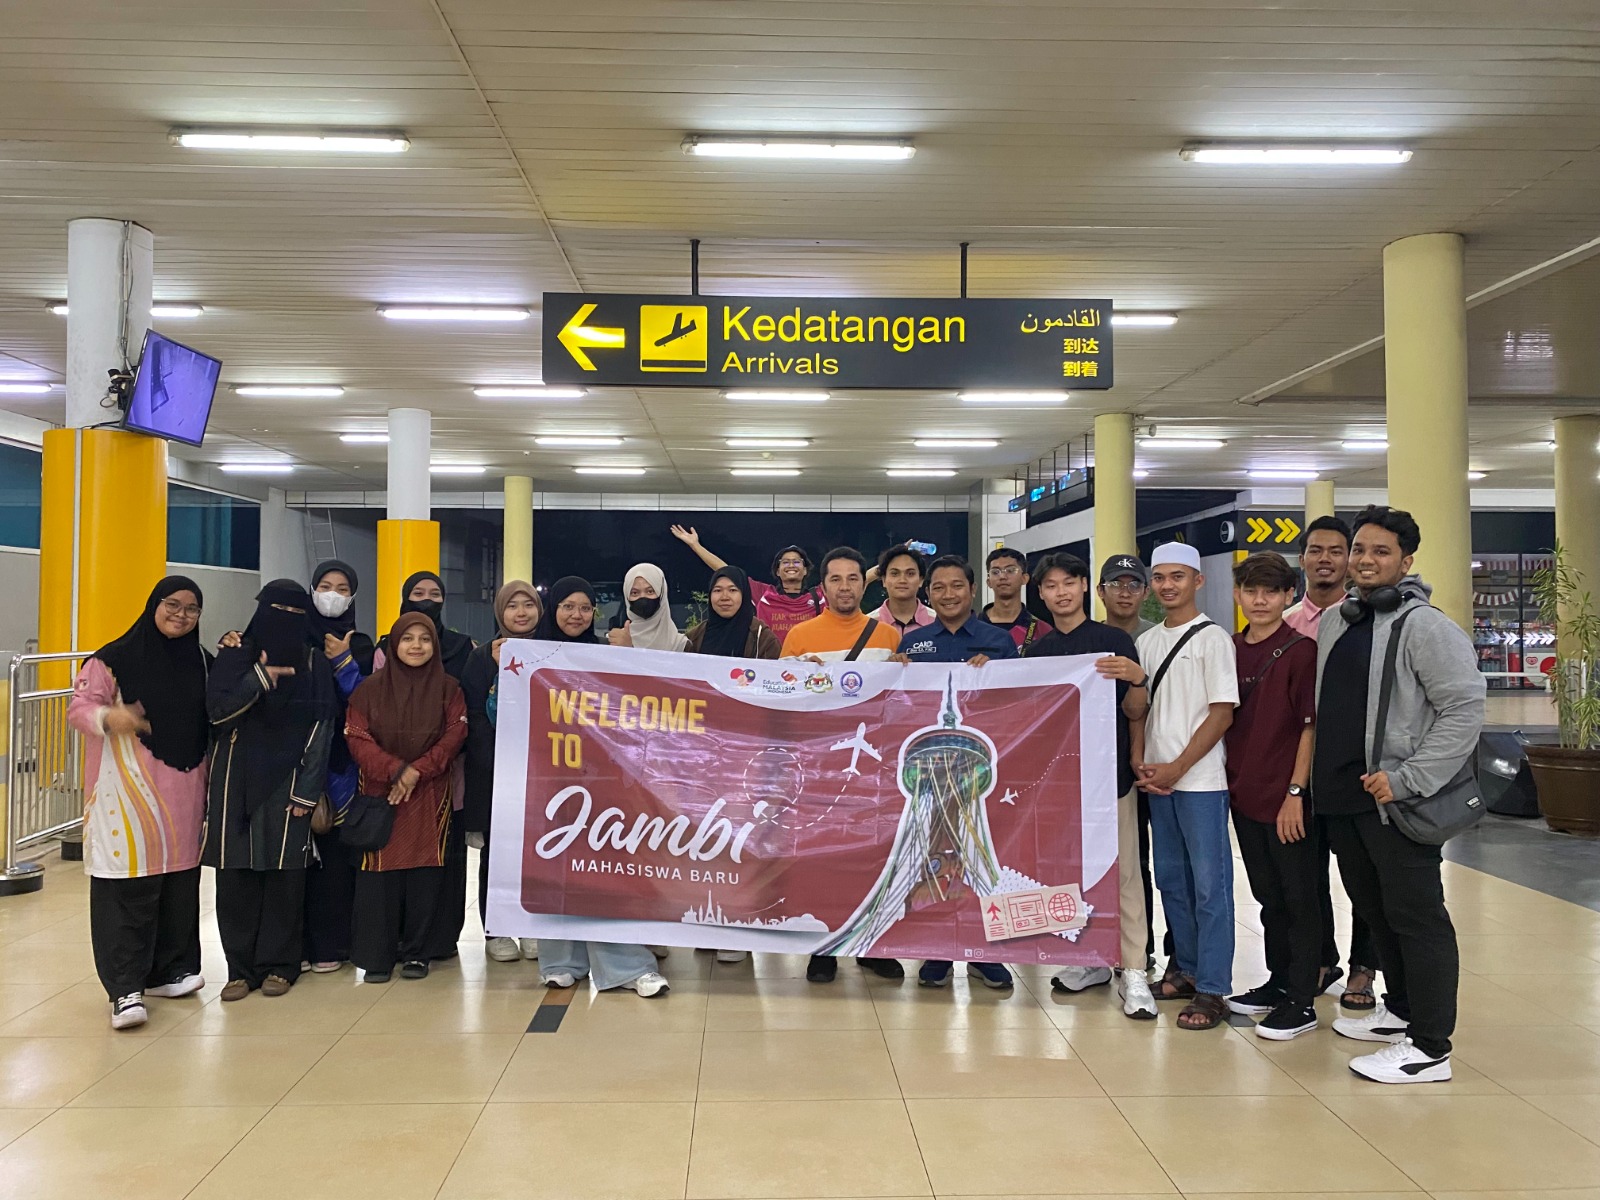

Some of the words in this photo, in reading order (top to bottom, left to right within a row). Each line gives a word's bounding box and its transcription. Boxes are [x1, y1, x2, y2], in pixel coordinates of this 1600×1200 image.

[722, 306, 966, 352] Kedatangan
[1020, 308, 1101, 333] القادمون
[1063, 337, 1100, 354] 到达
[721, 352, 840, 376] Arrivals
[1063, 360, 1099, 377] 到着
[549, 688, 708, 734] WELCOME
[547, 731, 583, 769] TO
[535, 786, 769, 863] Jambi
[571, 858, 683, 882] MAHASISWA
[689, 868, 741, 886] BARU
